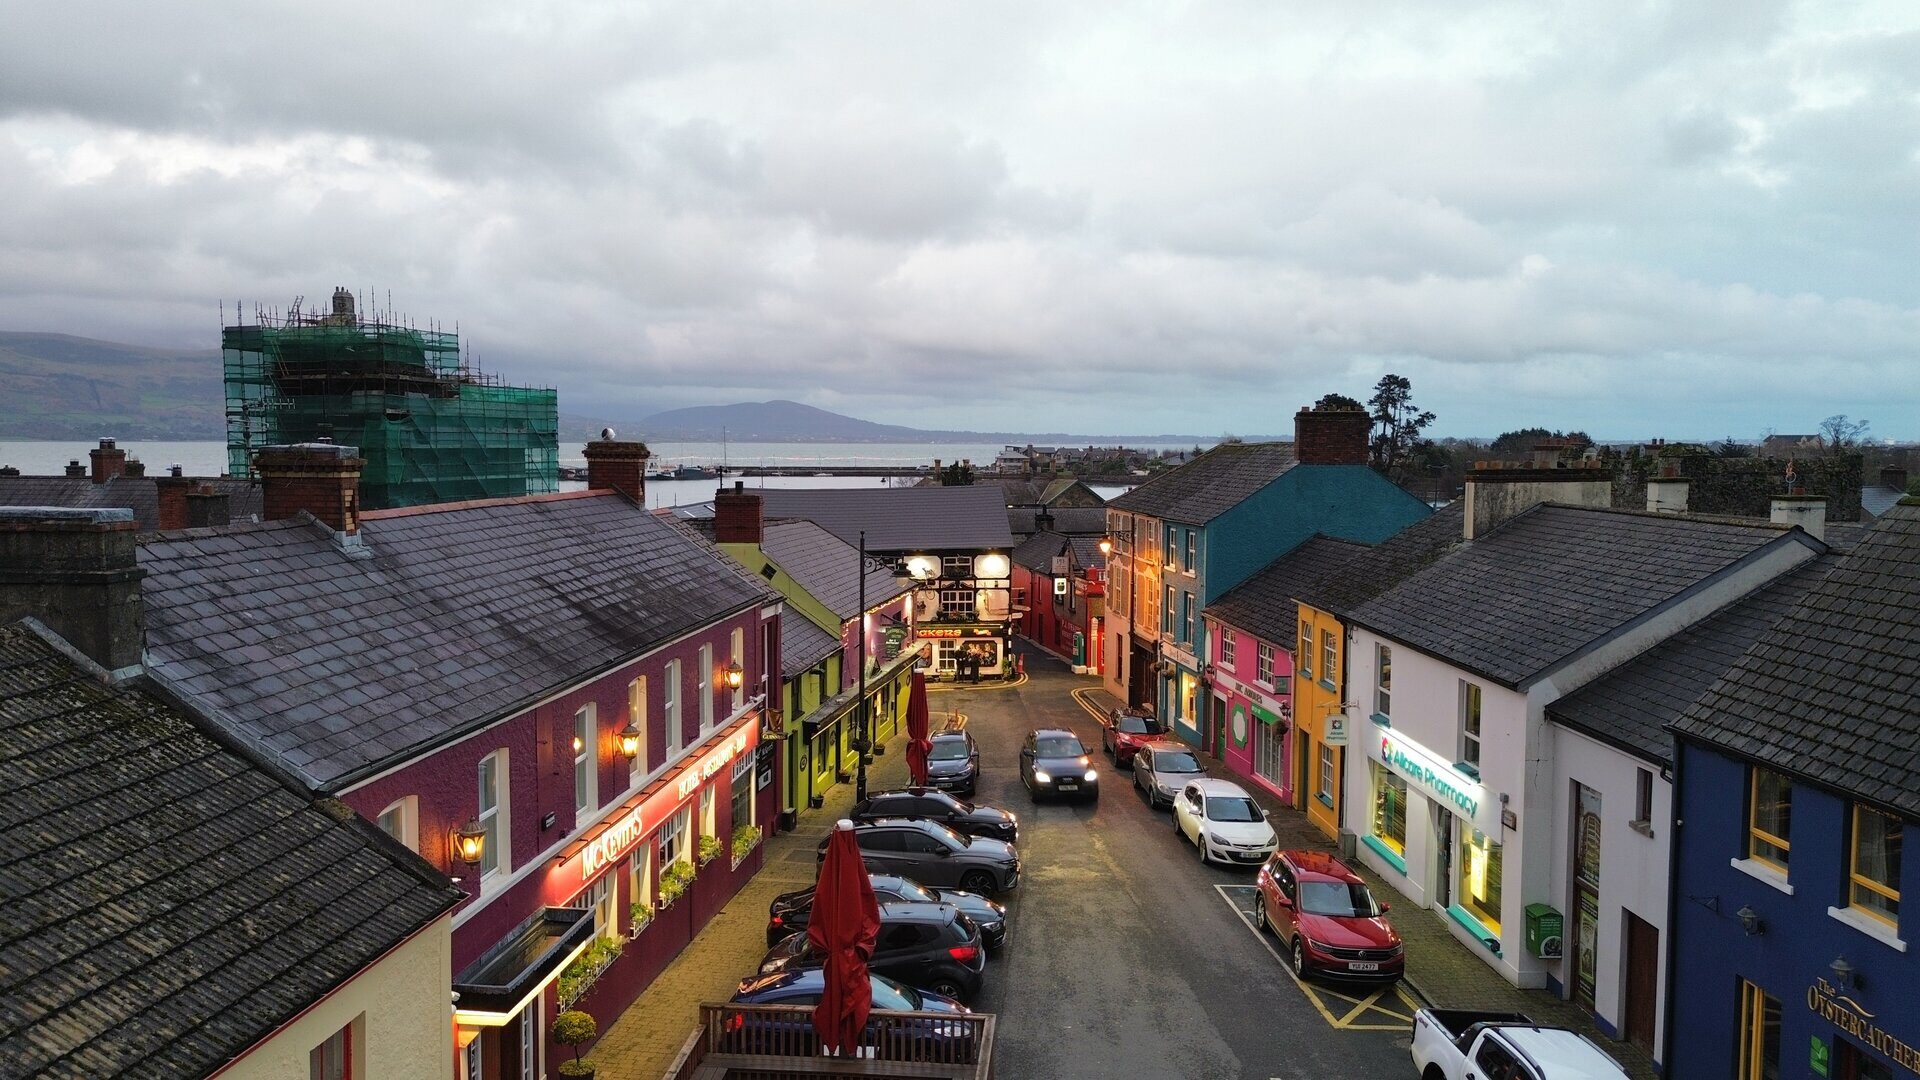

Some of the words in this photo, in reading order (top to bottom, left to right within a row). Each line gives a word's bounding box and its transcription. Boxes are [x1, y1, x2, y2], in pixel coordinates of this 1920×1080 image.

[1393, 750, 1423, 781] Allcare
[1424, 767, 1478, 819] Pharmacy
[1817, 976, 1836, 996] The
